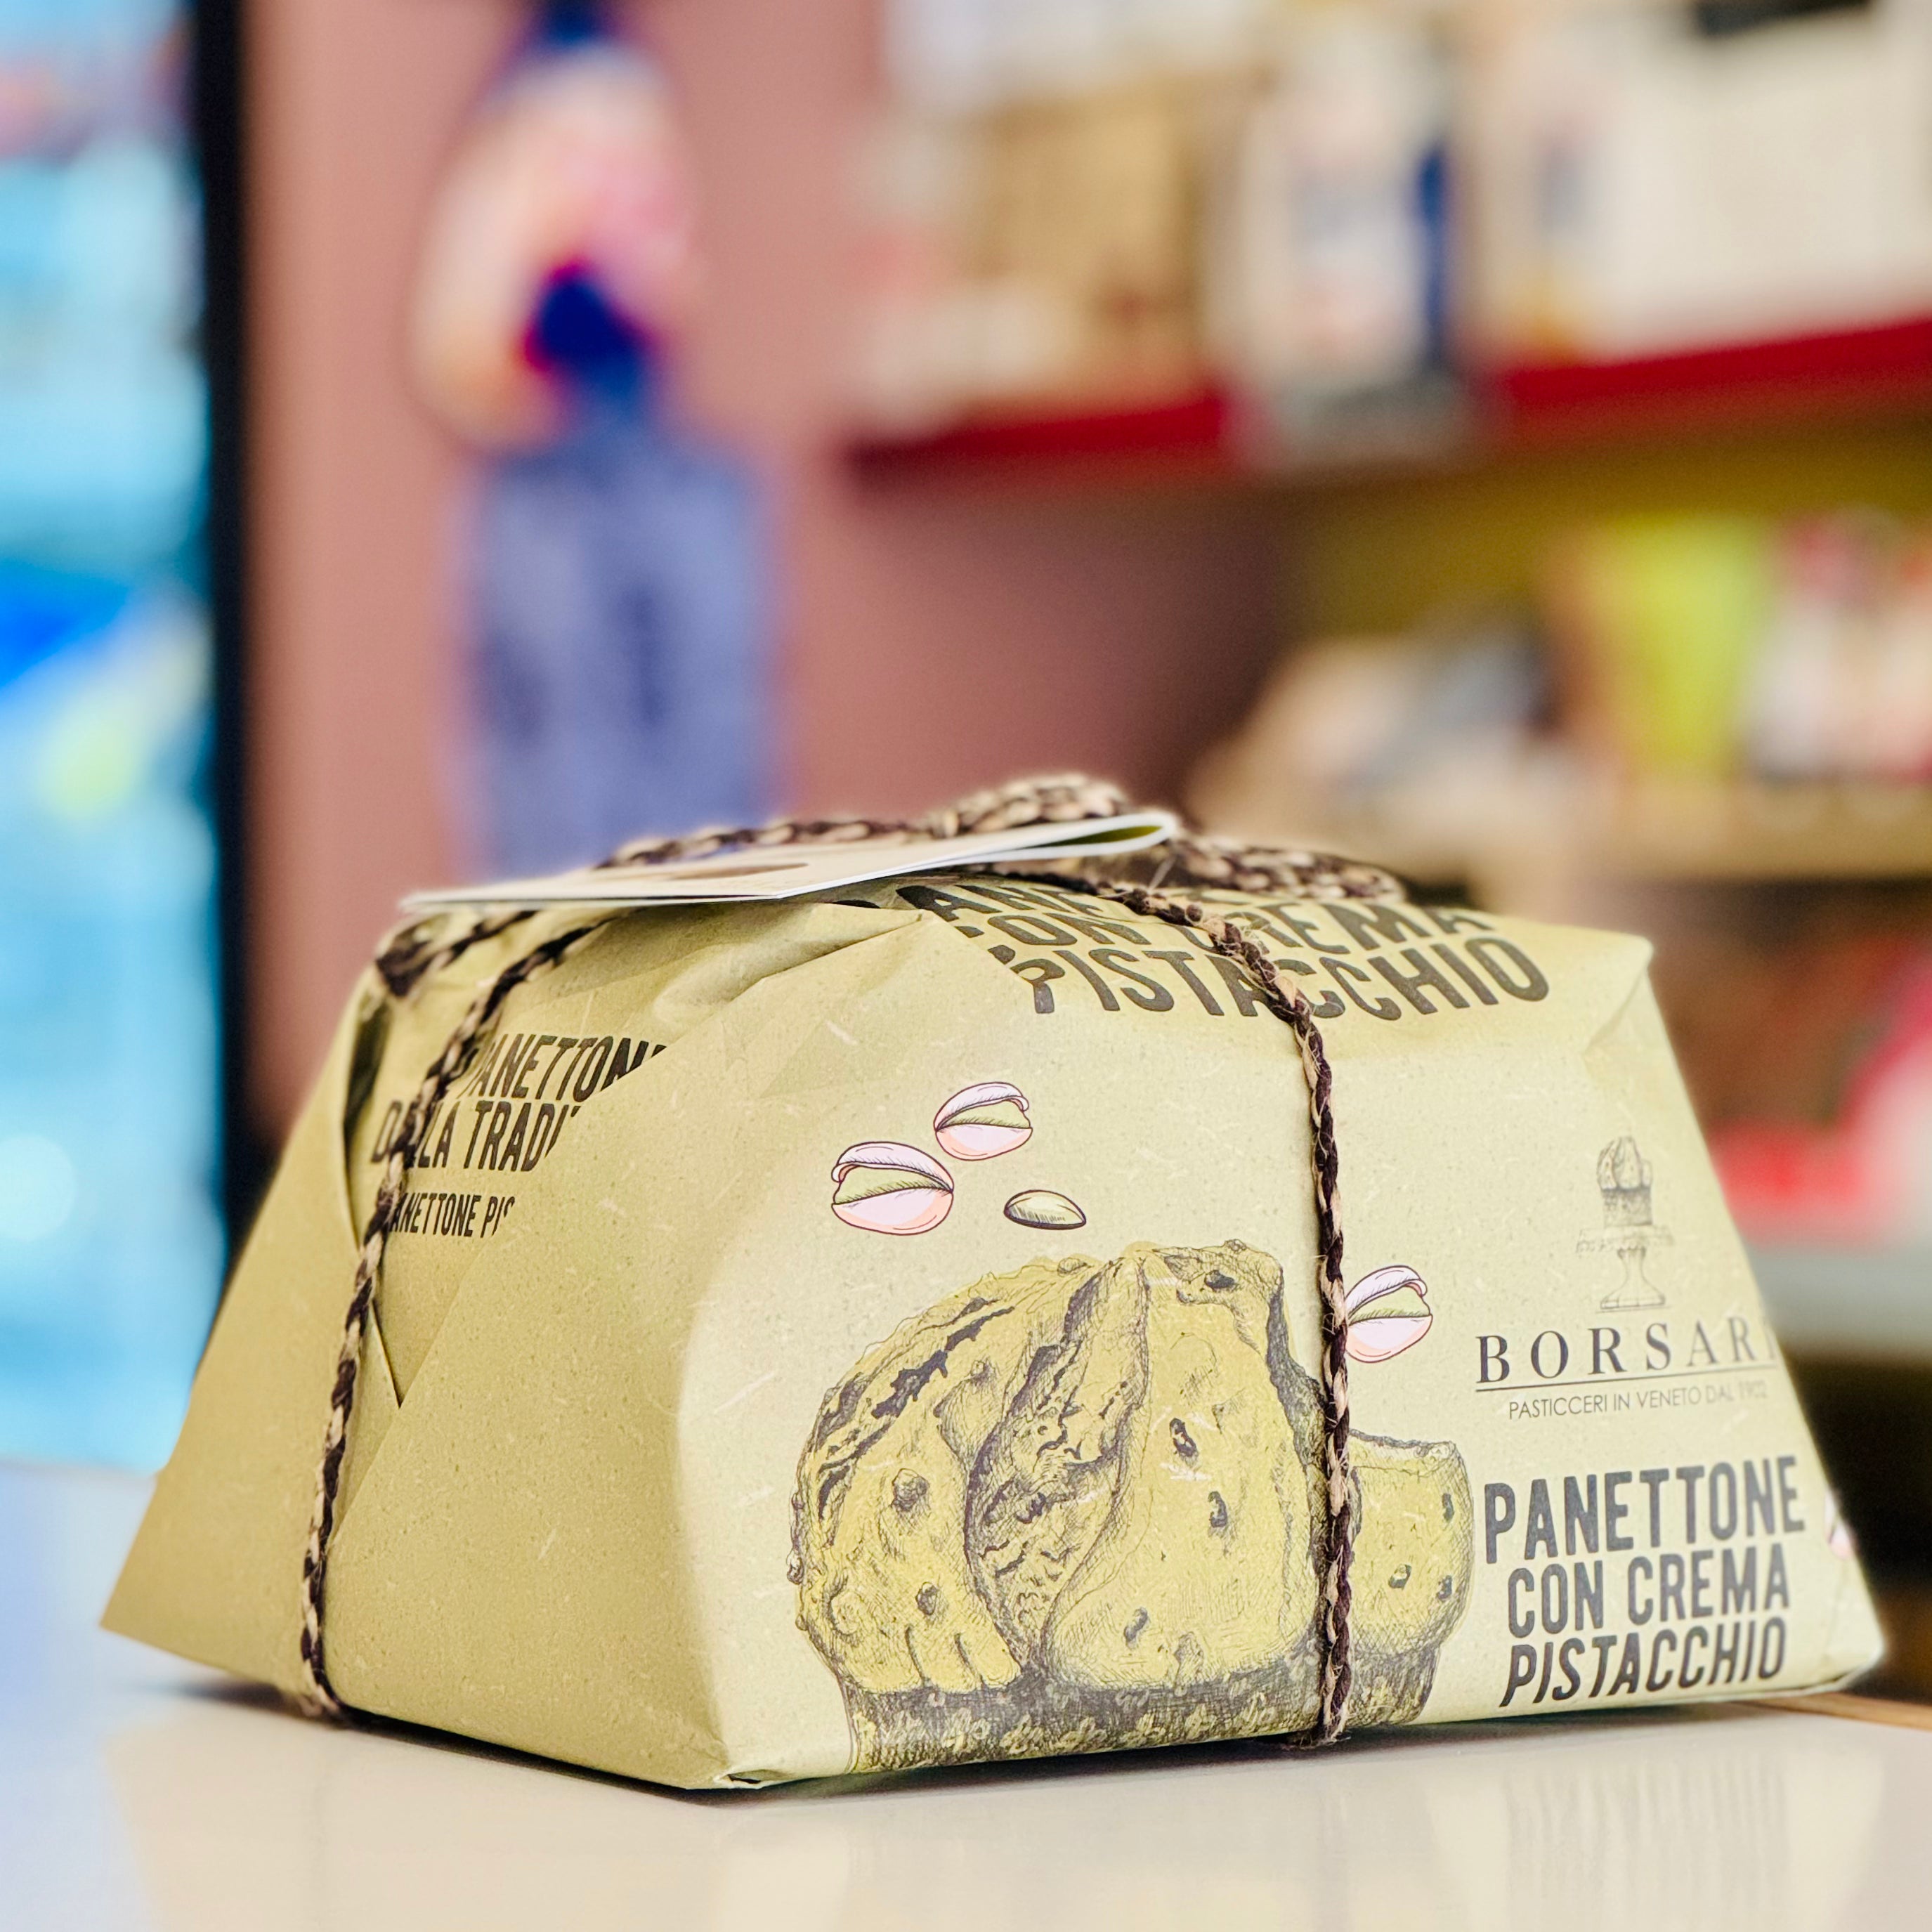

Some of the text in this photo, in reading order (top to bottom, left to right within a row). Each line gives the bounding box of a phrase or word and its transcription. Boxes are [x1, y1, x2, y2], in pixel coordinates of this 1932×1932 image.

[955, 913, 1151, 946] ON
[464, 1100, 581, 1173] TRADI
[391, 1192, 482, 1237] ANETTONE
[1509, 1394, 1607, 1420] PASTICCERI
[1613, 1393, 1630, 1411] IN
[1636, 1386, 1702, 1409] VENETO
[1484, 1456, 1805, 1564] PANETTONE
[1508, 1543, 1789, 1638] CON CREMA
[1499, 1617, 1787, 1707] PISTACCHIO
